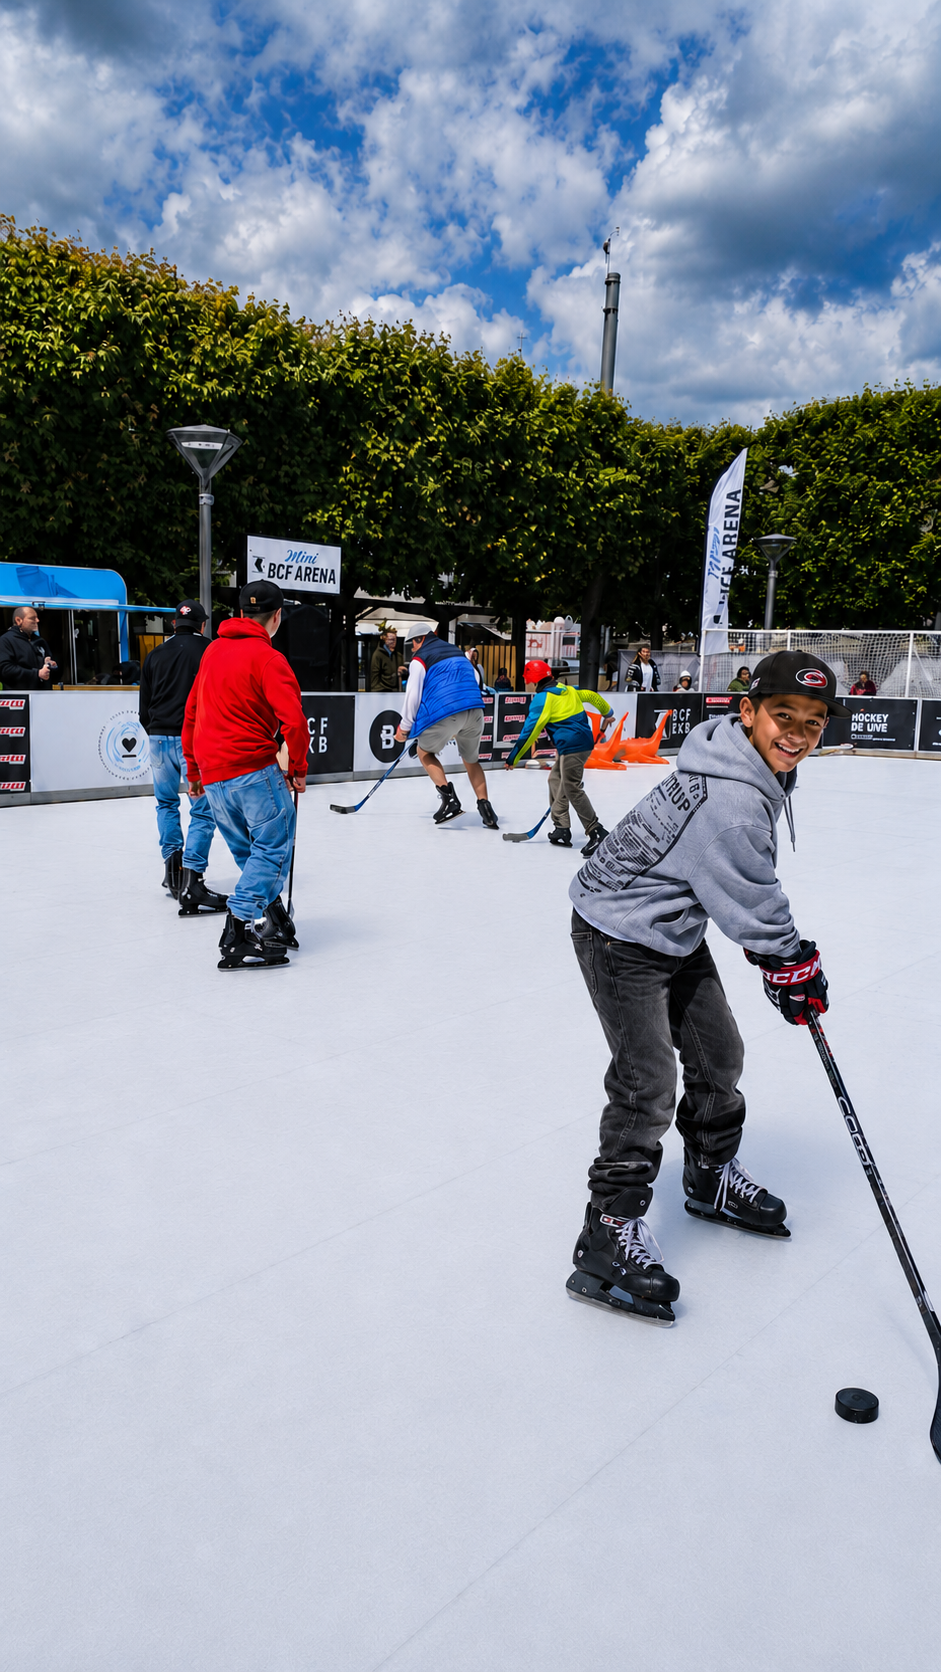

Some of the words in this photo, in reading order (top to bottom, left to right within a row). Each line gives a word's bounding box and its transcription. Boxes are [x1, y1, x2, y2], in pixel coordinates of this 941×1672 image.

[722, 489, 741, 560] ARENA
[284, 549, 319, 564] Mini
[267, 562, 293, 580] BCF
[294, 565, 336, 584] ARENA
[672, 708, 691, 721] BCF
[851, 713, 889, 723] HOCKEY
[307, 717, 328, 735] CF
[851, 722, 864, 732] DE
[309, 736, 328, 753] KB
